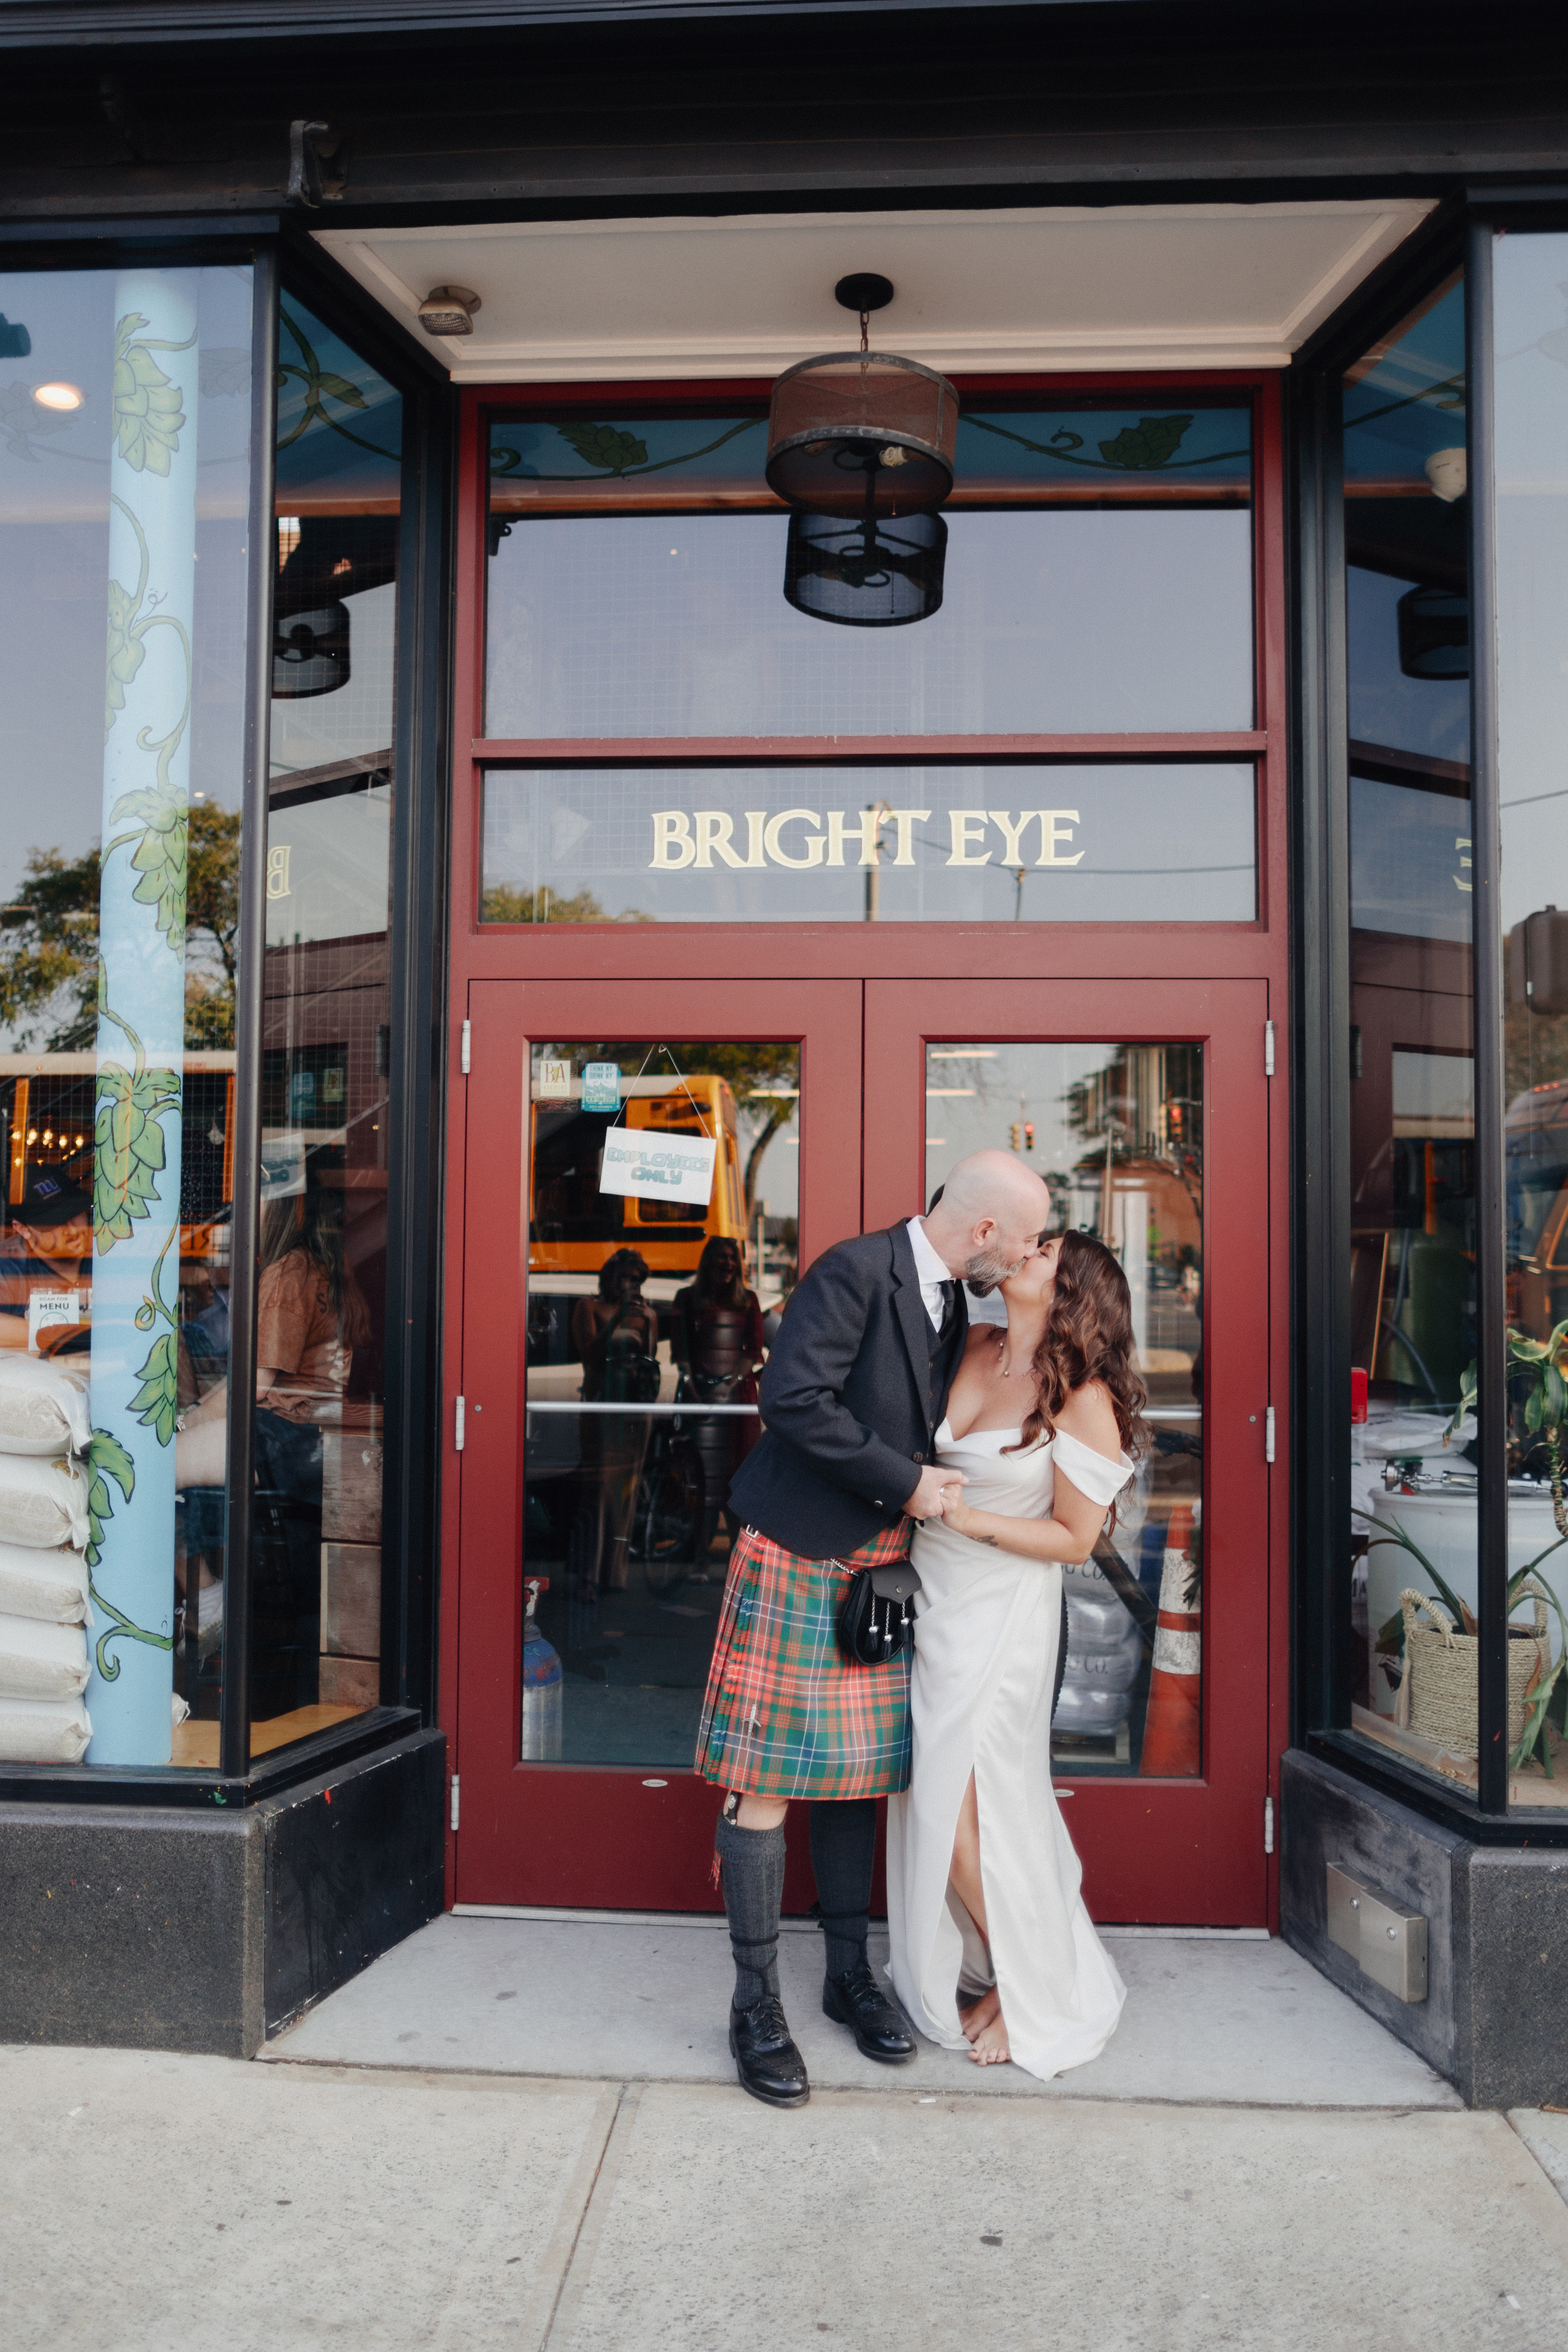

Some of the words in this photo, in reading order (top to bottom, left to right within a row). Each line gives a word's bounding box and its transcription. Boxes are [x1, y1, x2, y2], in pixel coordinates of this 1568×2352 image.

[648, 809, 932, 869] BRIGHT
[945, 810, 1085, 866] EYE
[606, 1147, 710, 1173] EMPLOYEES
[631, 1167, 682, 1185] ONLY
